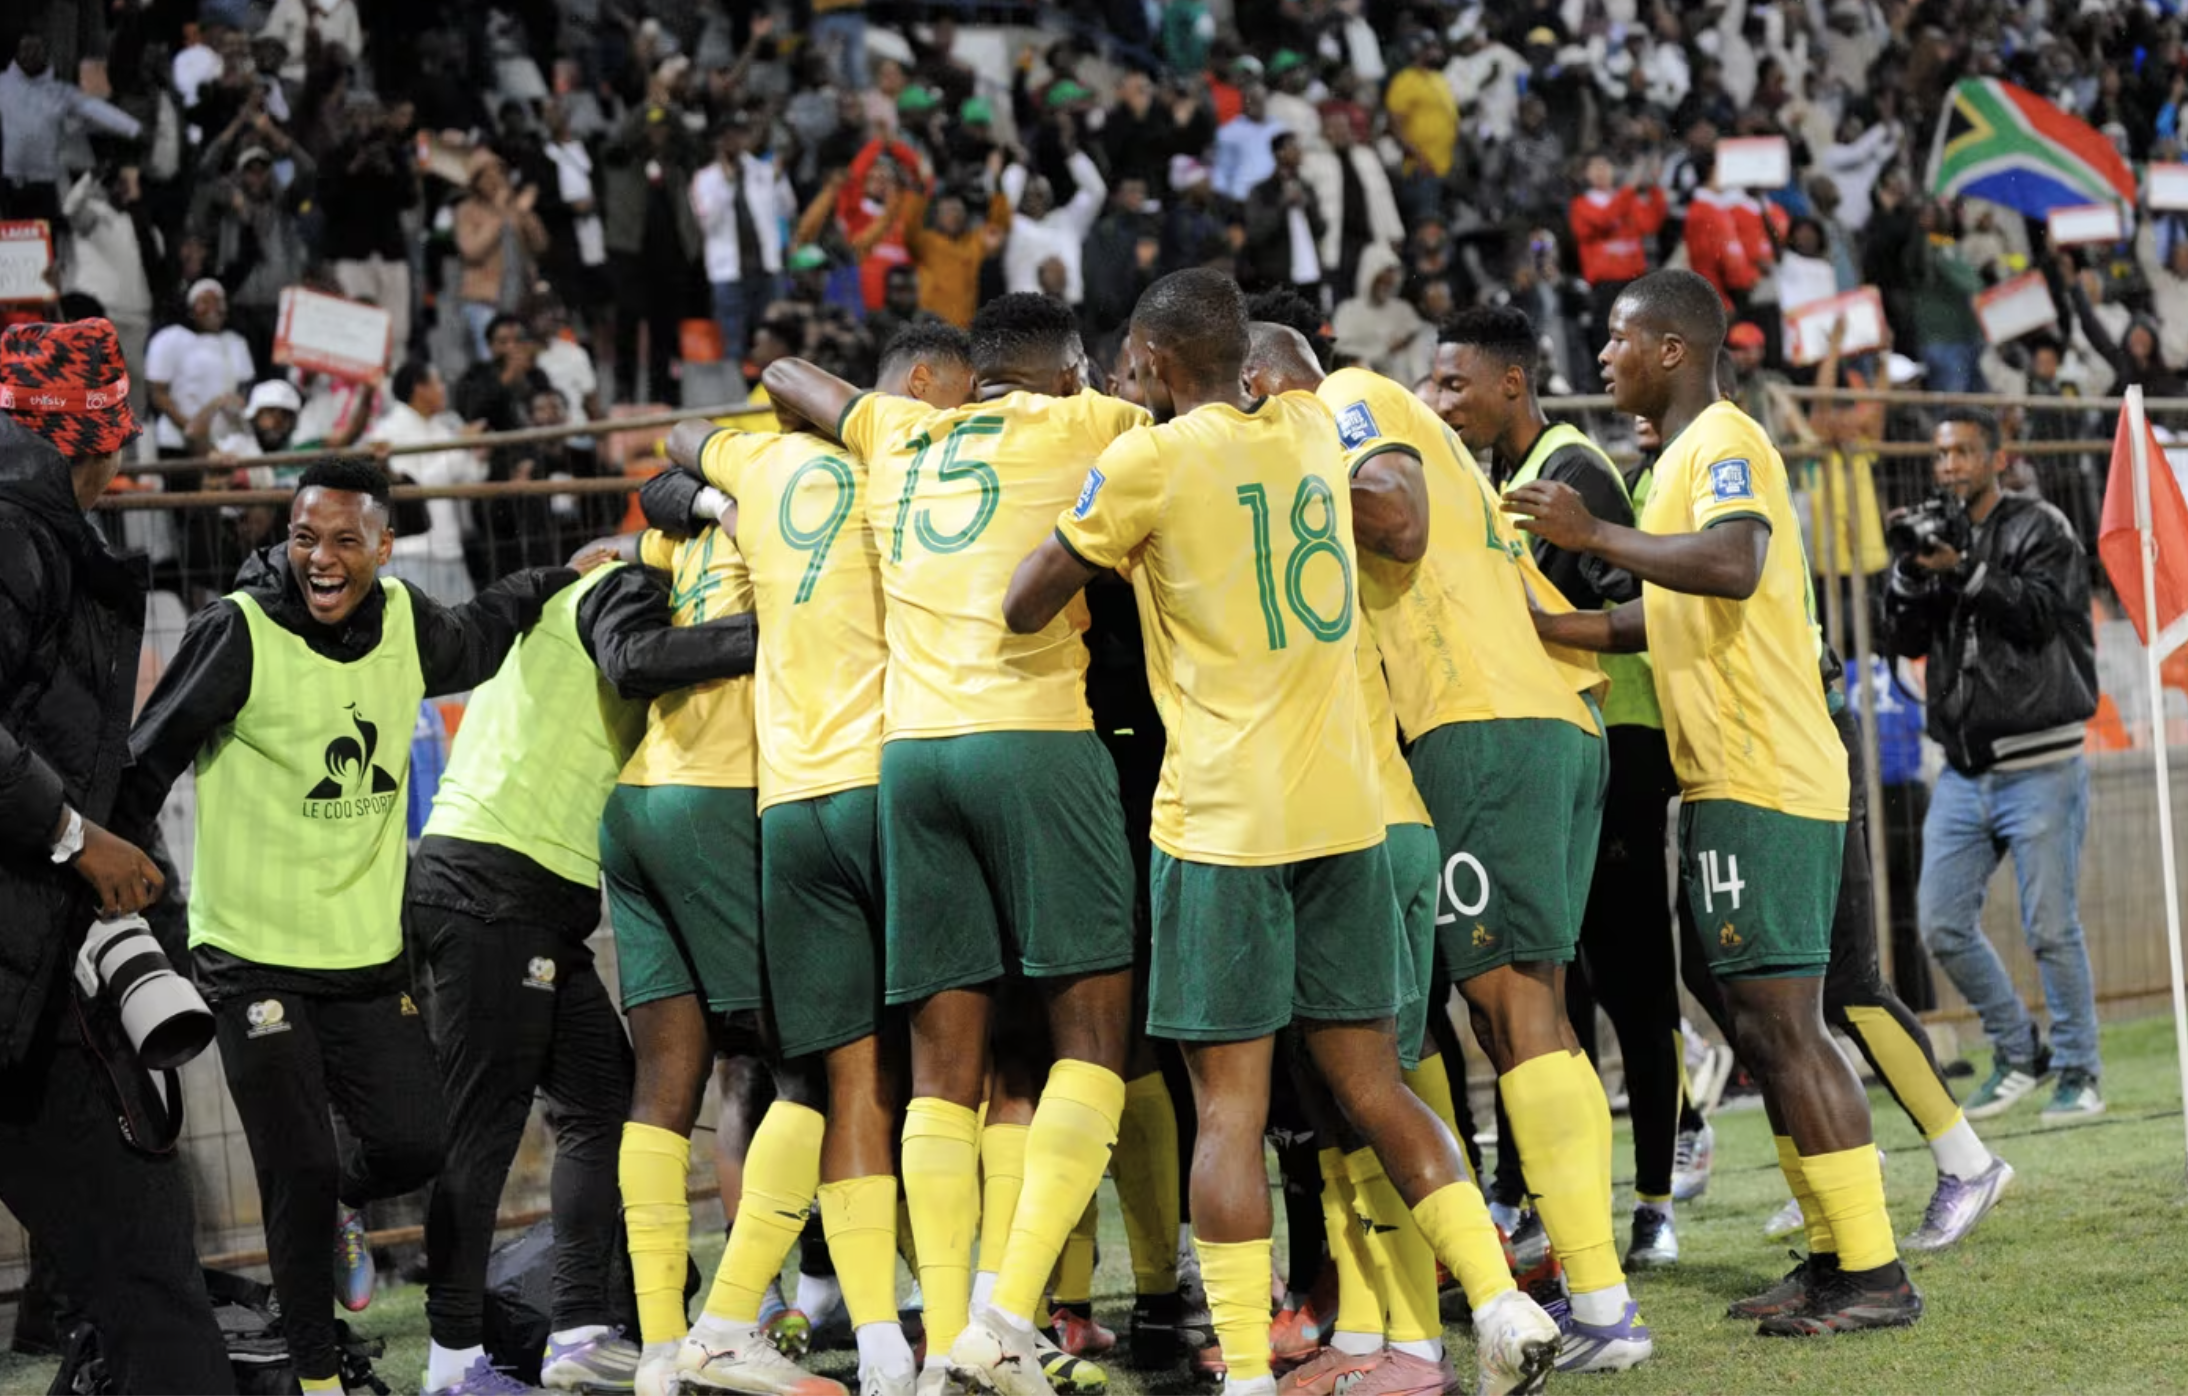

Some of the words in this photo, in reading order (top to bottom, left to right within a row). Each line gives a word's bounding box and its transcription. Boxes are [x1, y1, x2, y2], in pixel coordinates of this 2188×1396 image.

[778, 454, 856, 604] 9
[892, 415, 1004, 565] 15
[1236, 474, 1353, 651] 18
[302, 802, 320, 818] LE
[324, 801, 353, 819] COQ
[1698, 850, 1745, 913] 14
